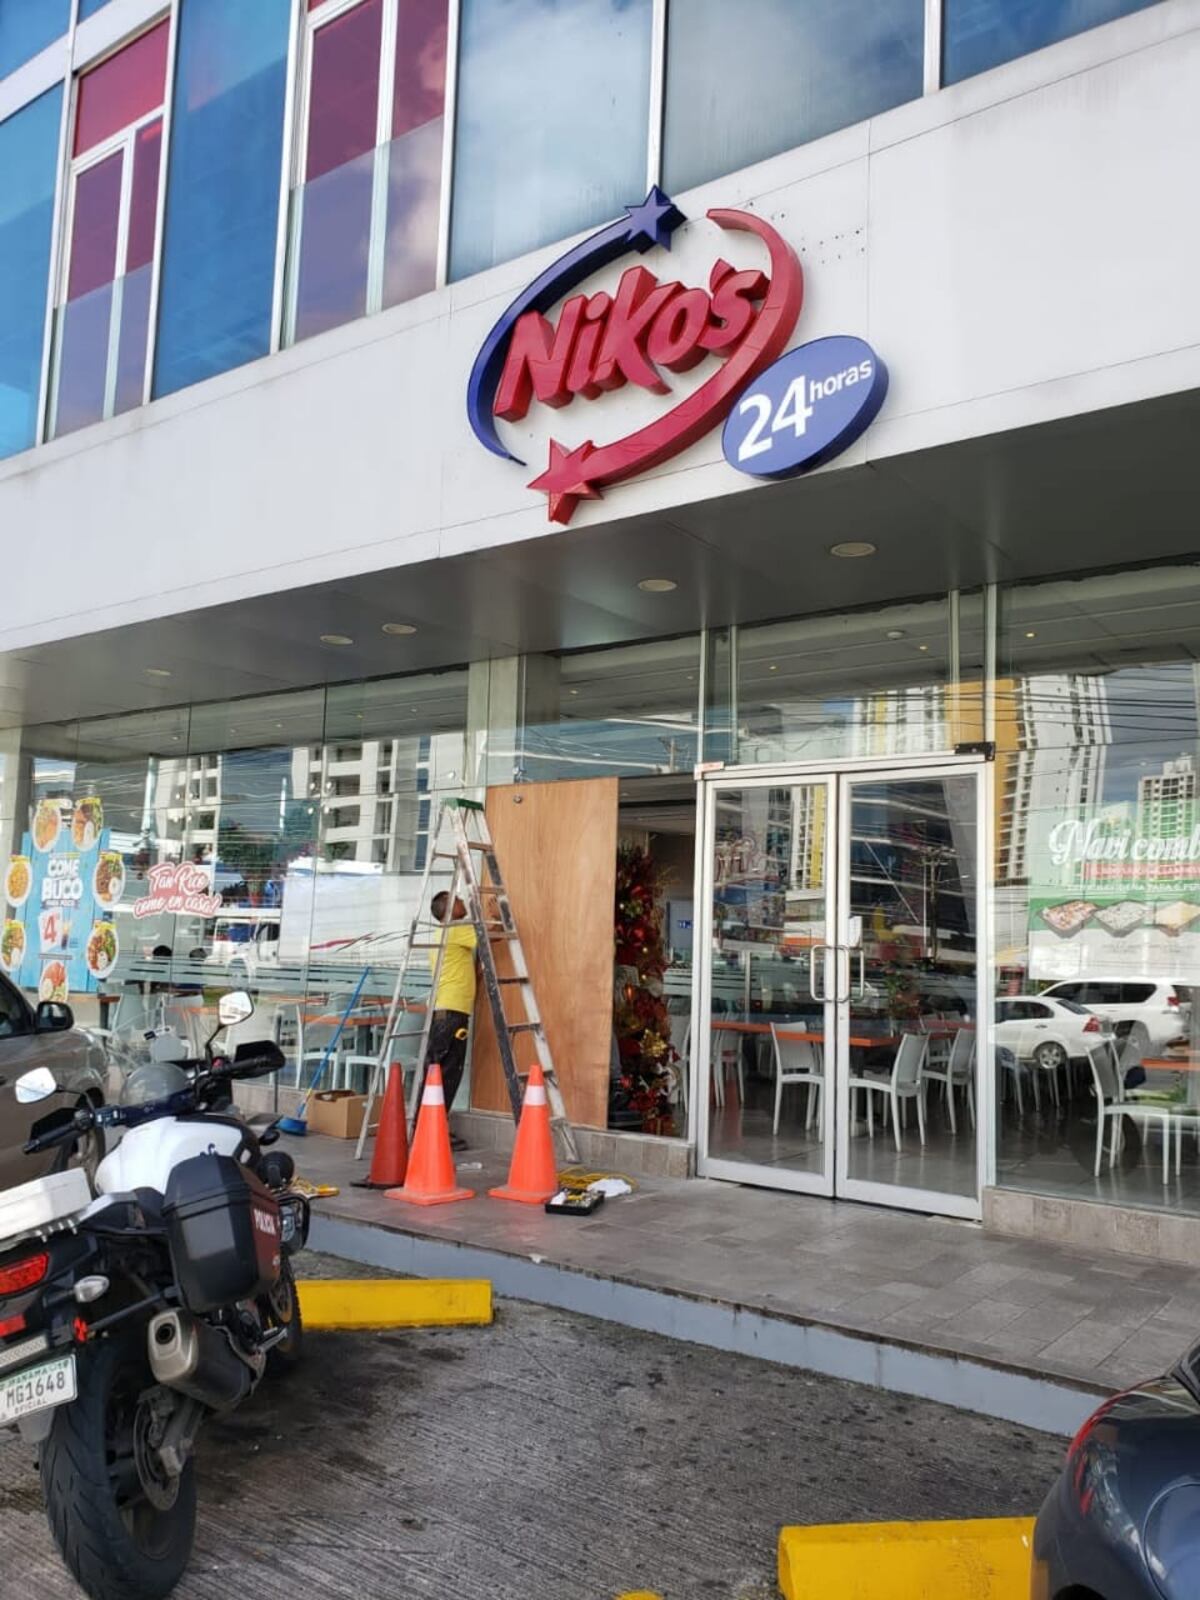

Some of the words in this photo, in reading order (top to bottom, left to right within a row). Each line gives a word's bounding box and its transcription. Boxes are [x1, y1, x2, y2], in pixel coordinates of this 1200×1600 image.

[738, 375, 813, 462] 24
[809, 359, 873, 403] horas
[48, 858, 80, 878] COME
[175, 864, 207, 896] Rico
[41, 877, 83, 901] BUCO
[167, 896, 183, 910] en
[6, 1370, 65, 1410] MG1648
